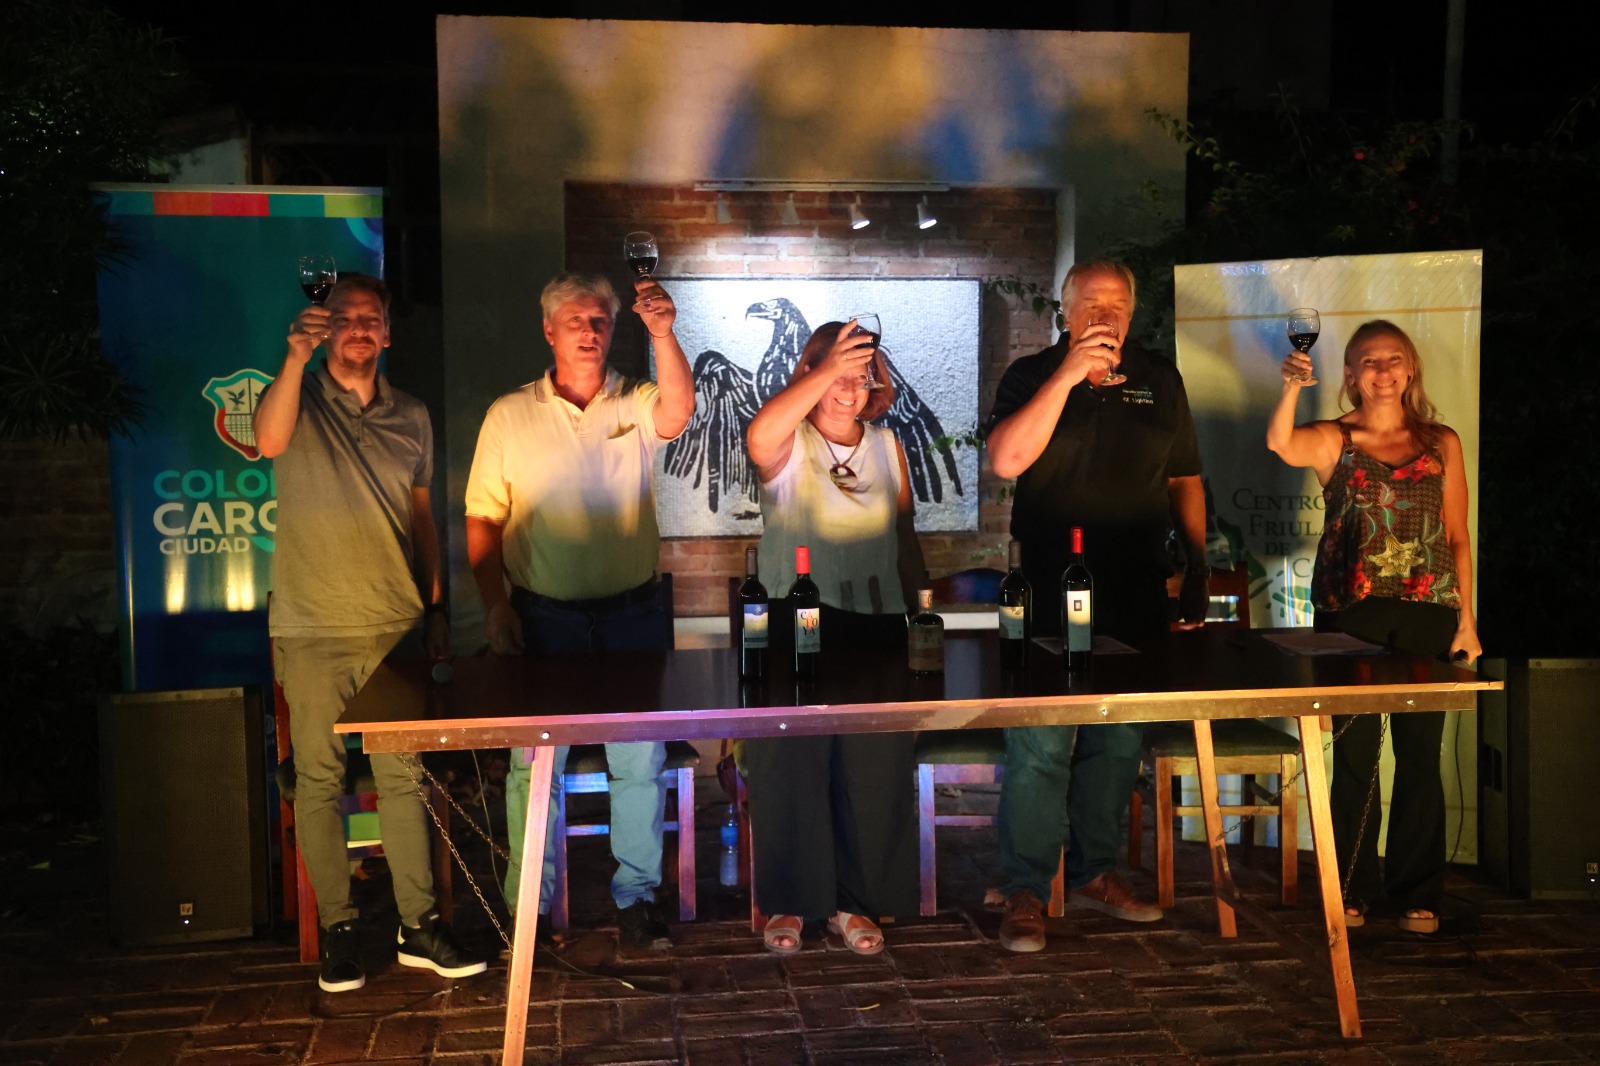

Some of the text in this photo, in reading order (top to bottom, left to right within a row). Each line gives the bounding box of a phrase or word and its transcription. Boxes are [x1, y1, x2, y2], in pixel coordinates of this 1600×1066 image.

[153, 468, 276, 499] COLO
[1232, 488, 1326, 511] CENTRO
[1248, 514, 1324, 536] FRIUL
[159, 537, 250, 555] CIUDAD
[1264, 541, 1291, 556] DE
